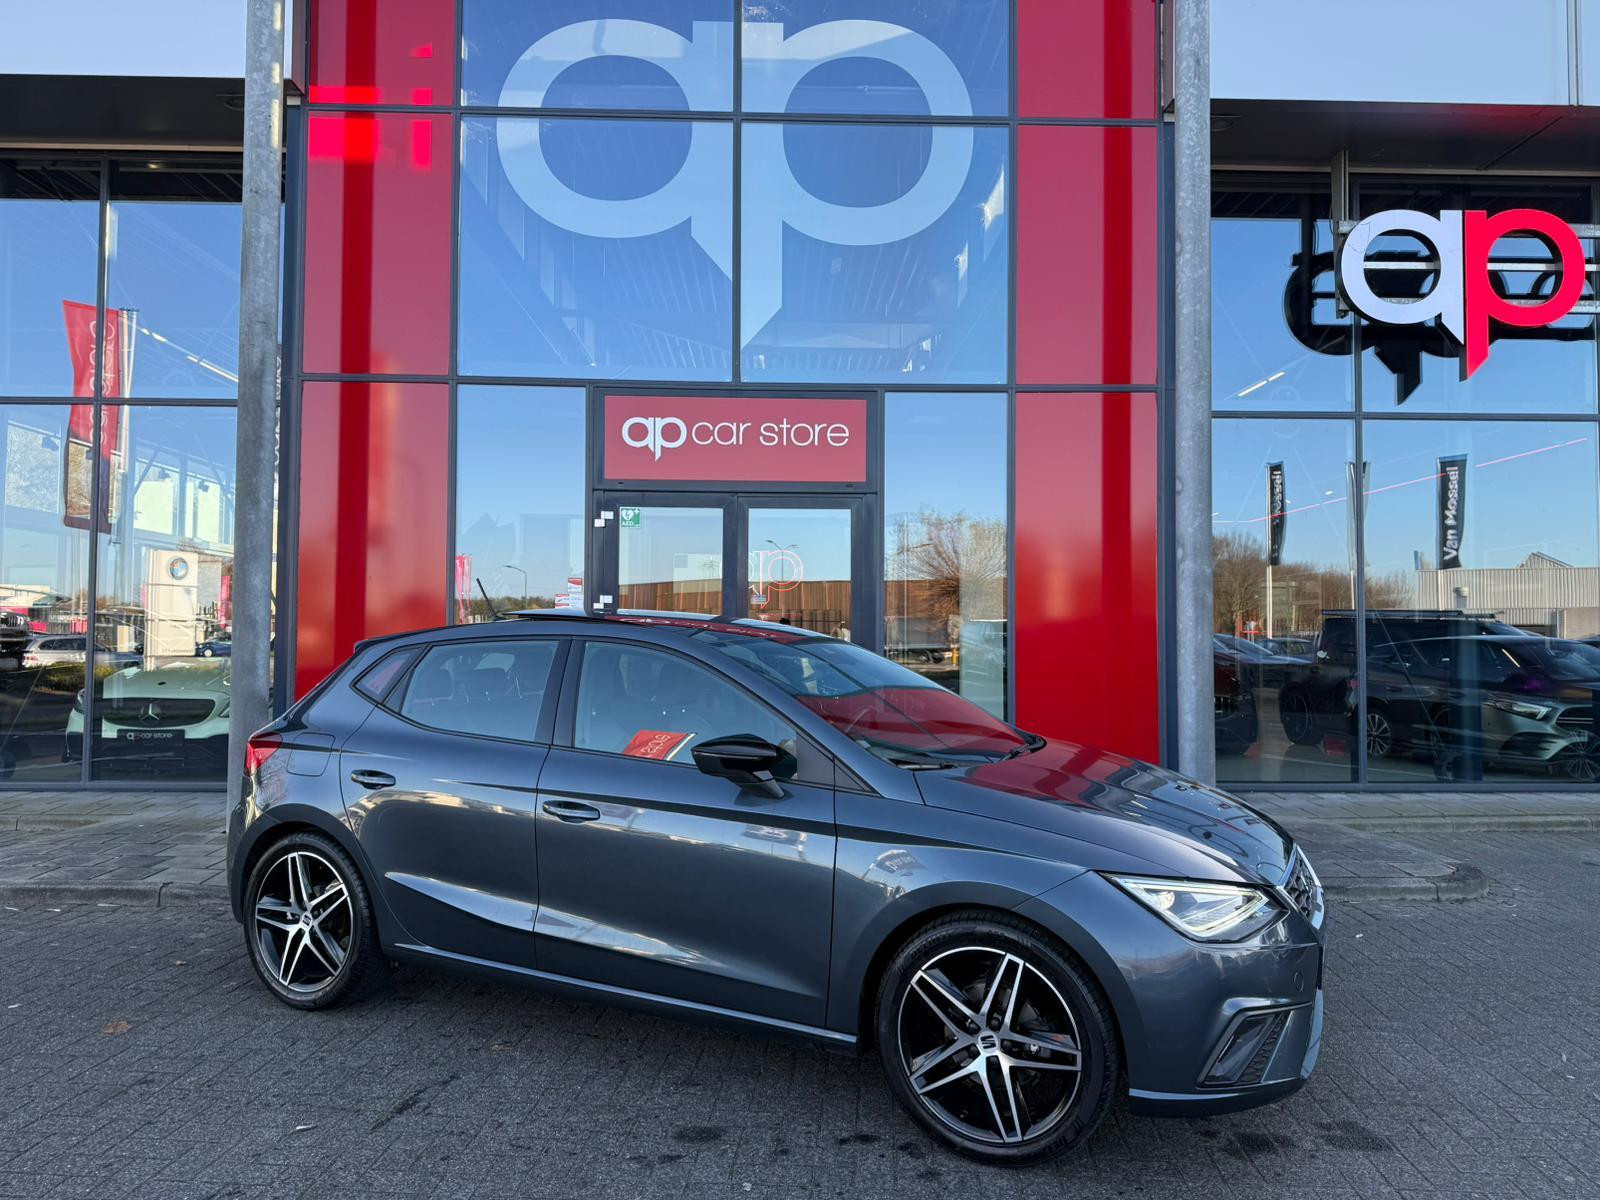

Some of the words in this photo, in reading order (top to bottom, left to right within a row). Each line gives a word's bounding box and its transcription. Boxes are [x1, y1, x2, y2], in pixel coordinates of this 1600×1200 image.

[1341, 208, 1585, 379] ap
[621, 416, 688, 462] ap
[691, 421, 752, 446] car
[759, 418, 850, 447] store
[1444, 466, 1460, 526] Mossel
[1443, 529, 1459, 560] Van
